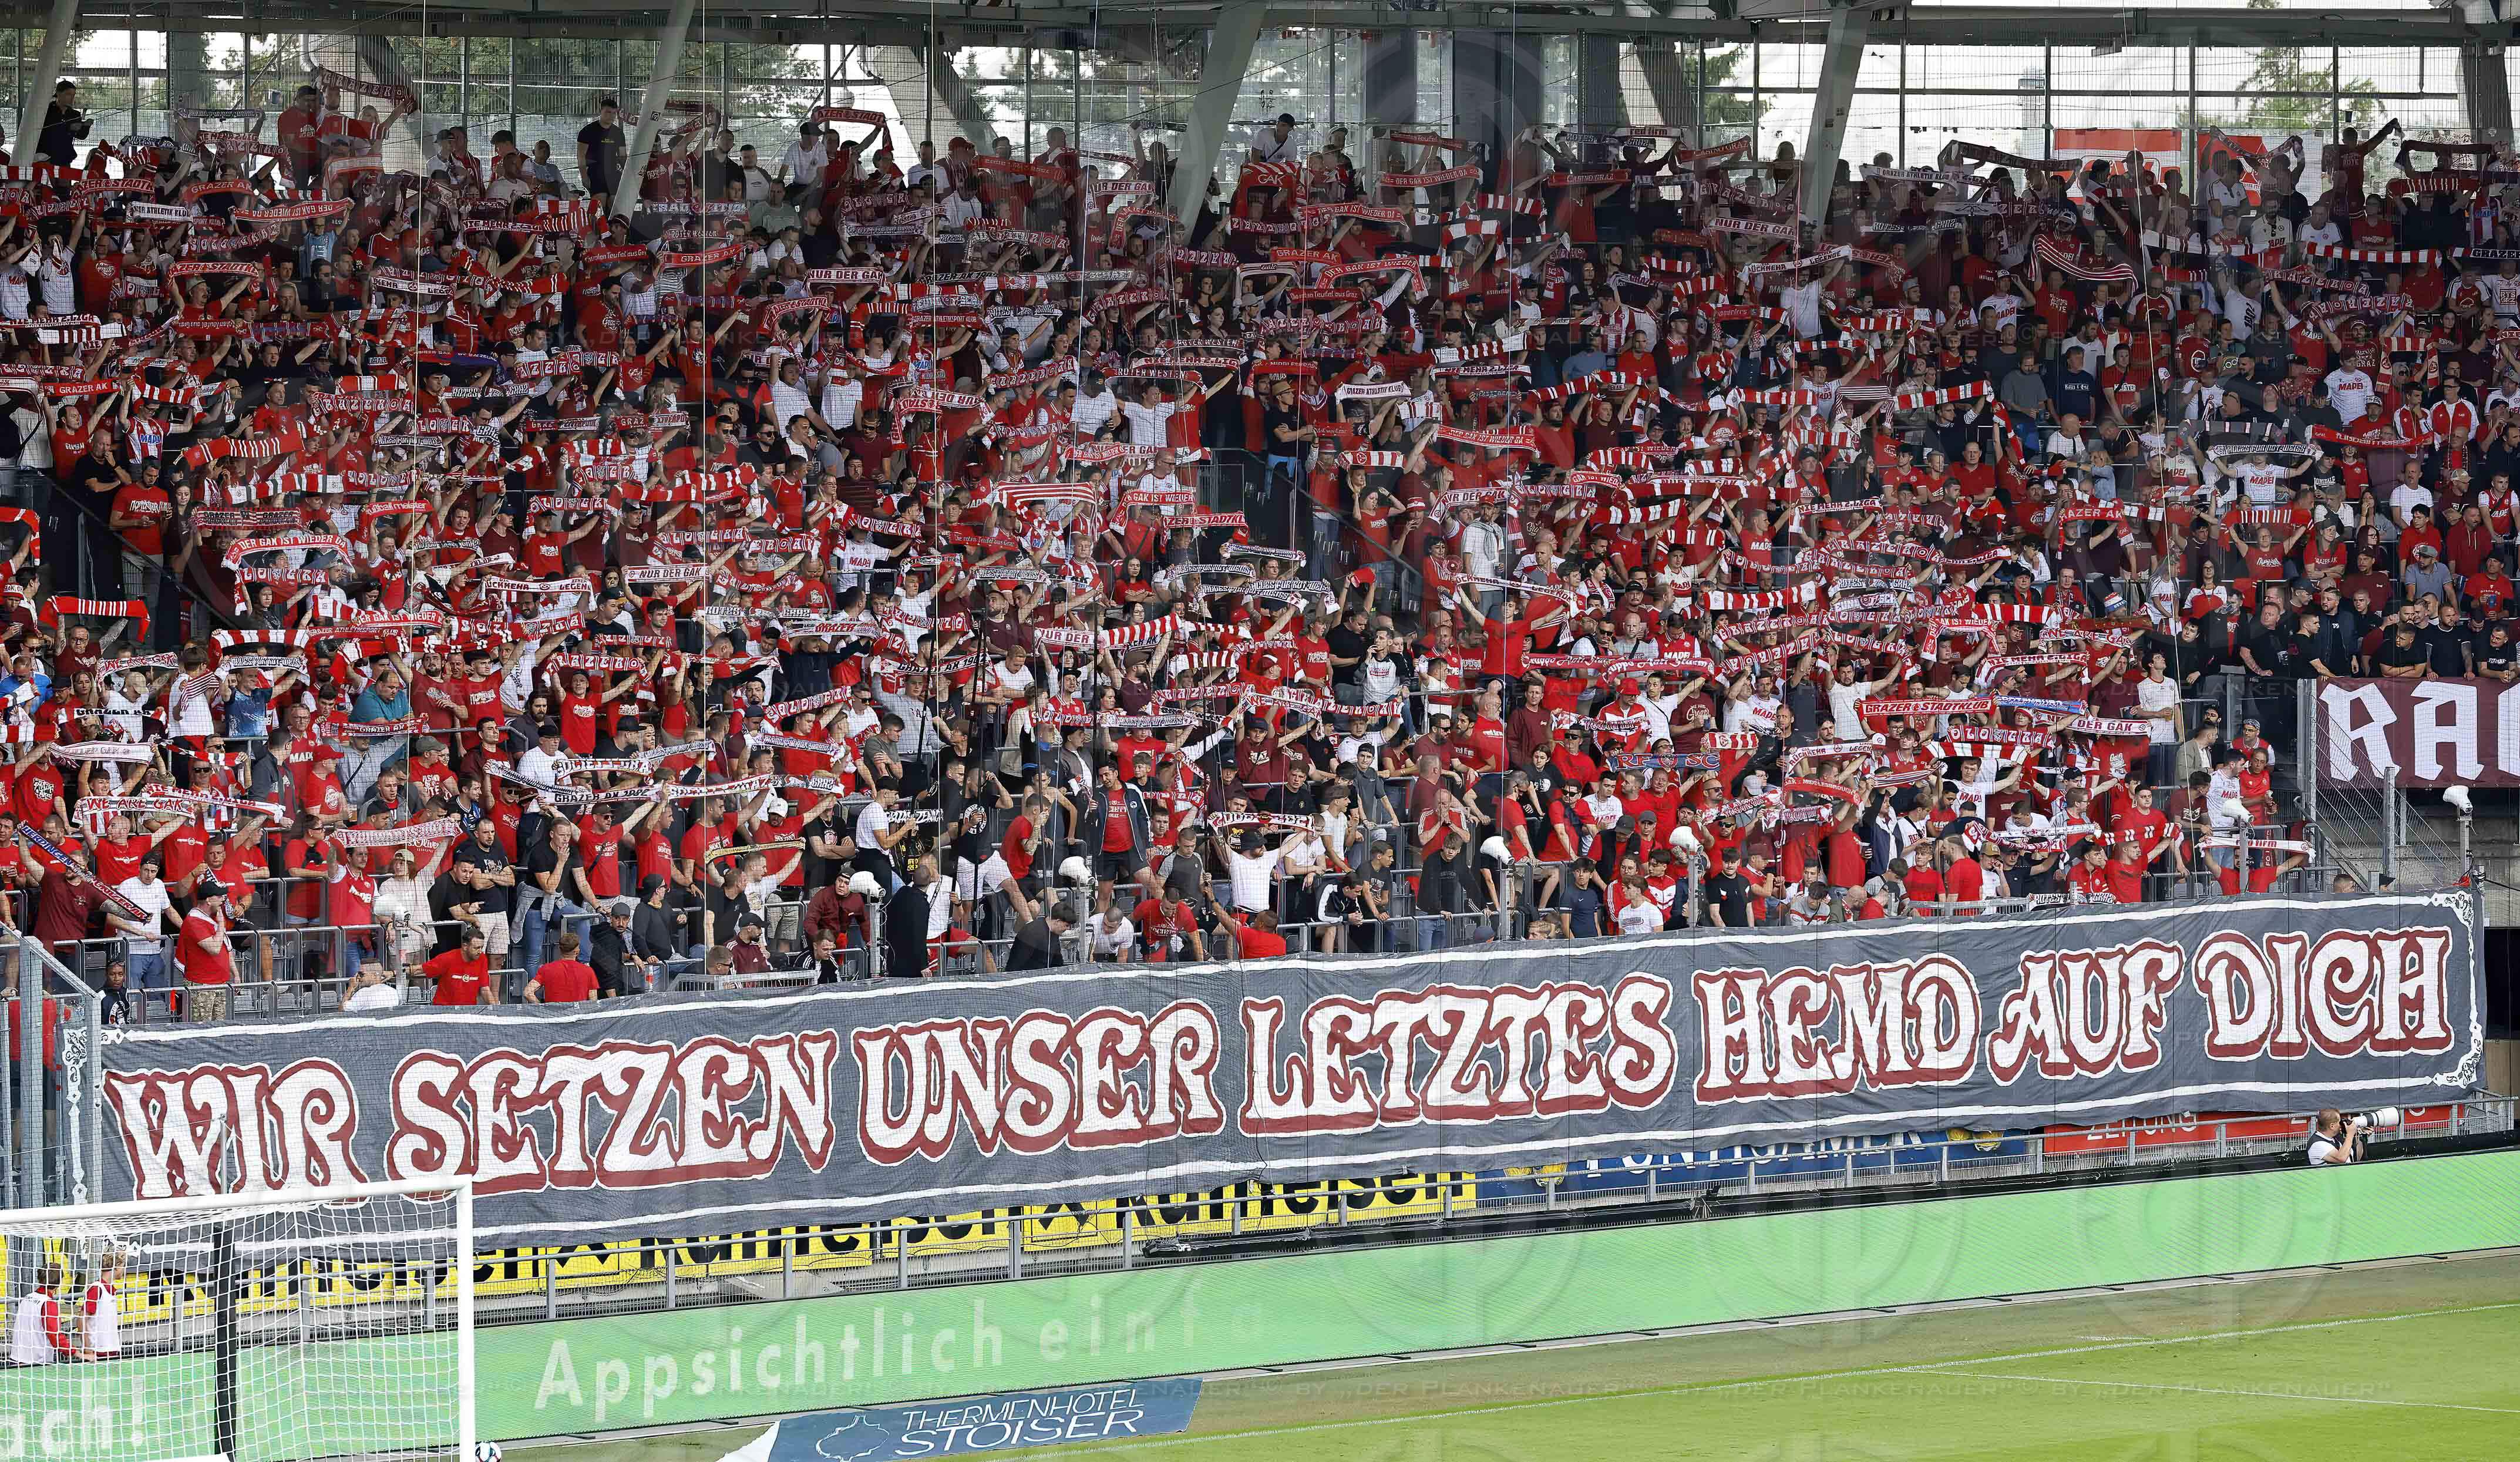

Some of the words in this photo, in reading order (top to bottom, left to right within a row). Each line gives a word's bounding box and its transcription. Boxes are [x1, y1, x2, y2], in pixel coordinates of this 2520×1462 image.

[1715, 219, 1740, 229] NUR
[1744, 221, 1767, 232] DER
[1276, 250, 1320, 258] GRAZER
[1322, 251, 1337, 263] AK
[836, 270, 859, 279] DER
[1344, 263, 1364, 274] GAK
[1117, 368, 1148, 377] ROTER
[59, 385, 93, 395] GRAZER
[95, 383, 108, 392] AK
[2249, 476, 2273, 485] MAPEI
[1133, 492, 1149, 502] GAK
[1150, 491, 1162, 501] IST
[1462, 492, 1479, 501] DER
[2067, 508, 2100, 518] AZER
[2105, 508, 2122, 518] AK
[240, 540, 256, 550] DER
[259, 538, 277, 546] GAK
[280, 537, 295, 545] IST
[297, 535, 334, 545] WIEDER
[335, 537, 346, 547] DA
[638, 570, 661, 579] NUR
[662, 569, 682, 578] DER
[682, 567, 701, 576] GAK
[704, 607, 741, 616] ROTES
[782, 607, 810, 617] GRAZ
[1065, 632, 1089, 644] DER
[1865, 703, 1911, 713] GRAZER
[1918, 701, 1989, 712] STADTKLUB
[359, 725, 390, 733] GRAZER
[2077, 719, 2105, 730] DER
[2107, 721, 2134, 732] GAK
[1616, 753, 1653, 769] RF
[1684, 753, 1720, 769] SC
[554, 792, 600, 803] GRAZER
[86, 798, 110, 811] WE
[116, 799, 145, 809] ARE
[153, 799, 183, 811] GAK
[94, 879, 133, 912] GRAZER
[102, 1056, 369, 1209] WIR
[385, 1027, 839, 1204] SETZEN
[850, 997, 1226, 1167] UNSER
[1237, 971, 1678, 1138] LETZTES
[1692, 953, 1981, 1106] HEMD
[1986, 937, 2186, 1087] AUF
[2192, 926, 2453, 1061] DICH
[535, 1299, 1002, 1421] Appsichtlich
[904, 1387, 1145, 1431] THERMENHOTEL
[894, 1409, 1145, 1457] STOISER
